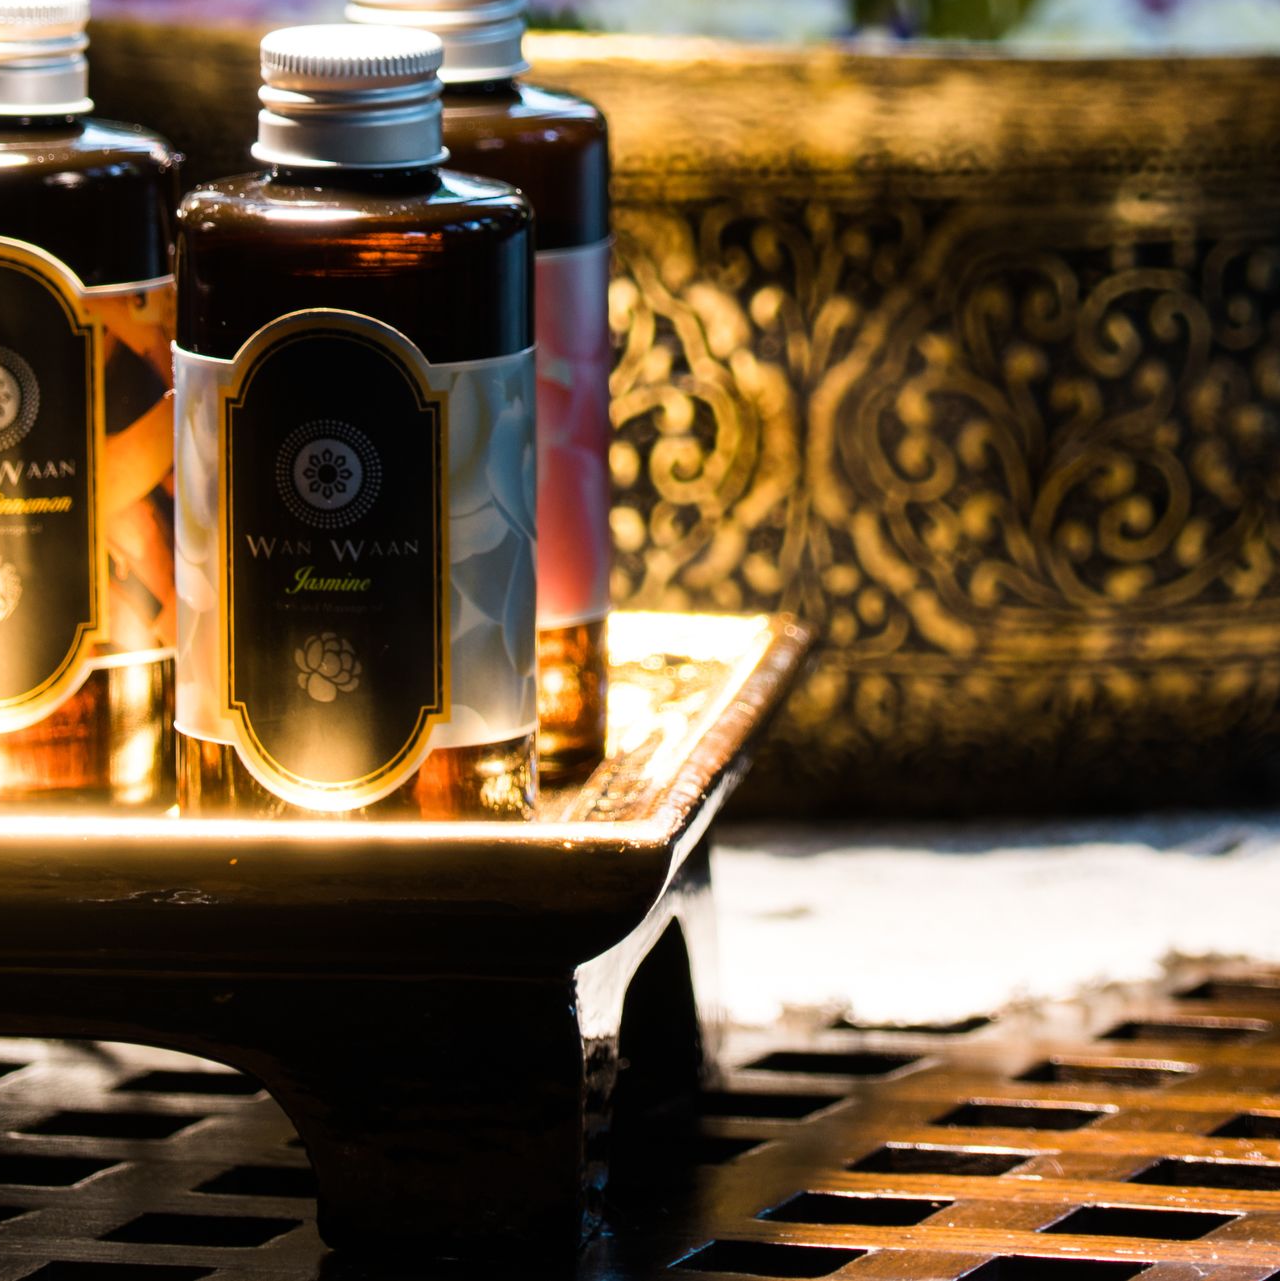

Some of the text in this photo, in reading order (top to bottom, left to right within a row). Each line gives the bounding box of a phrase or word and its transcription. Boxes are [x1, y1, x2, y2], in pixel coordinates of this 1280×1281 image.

[246, 534, 419, 562] WAN WAAN
[285, 566, 372, 595] Jasmine
